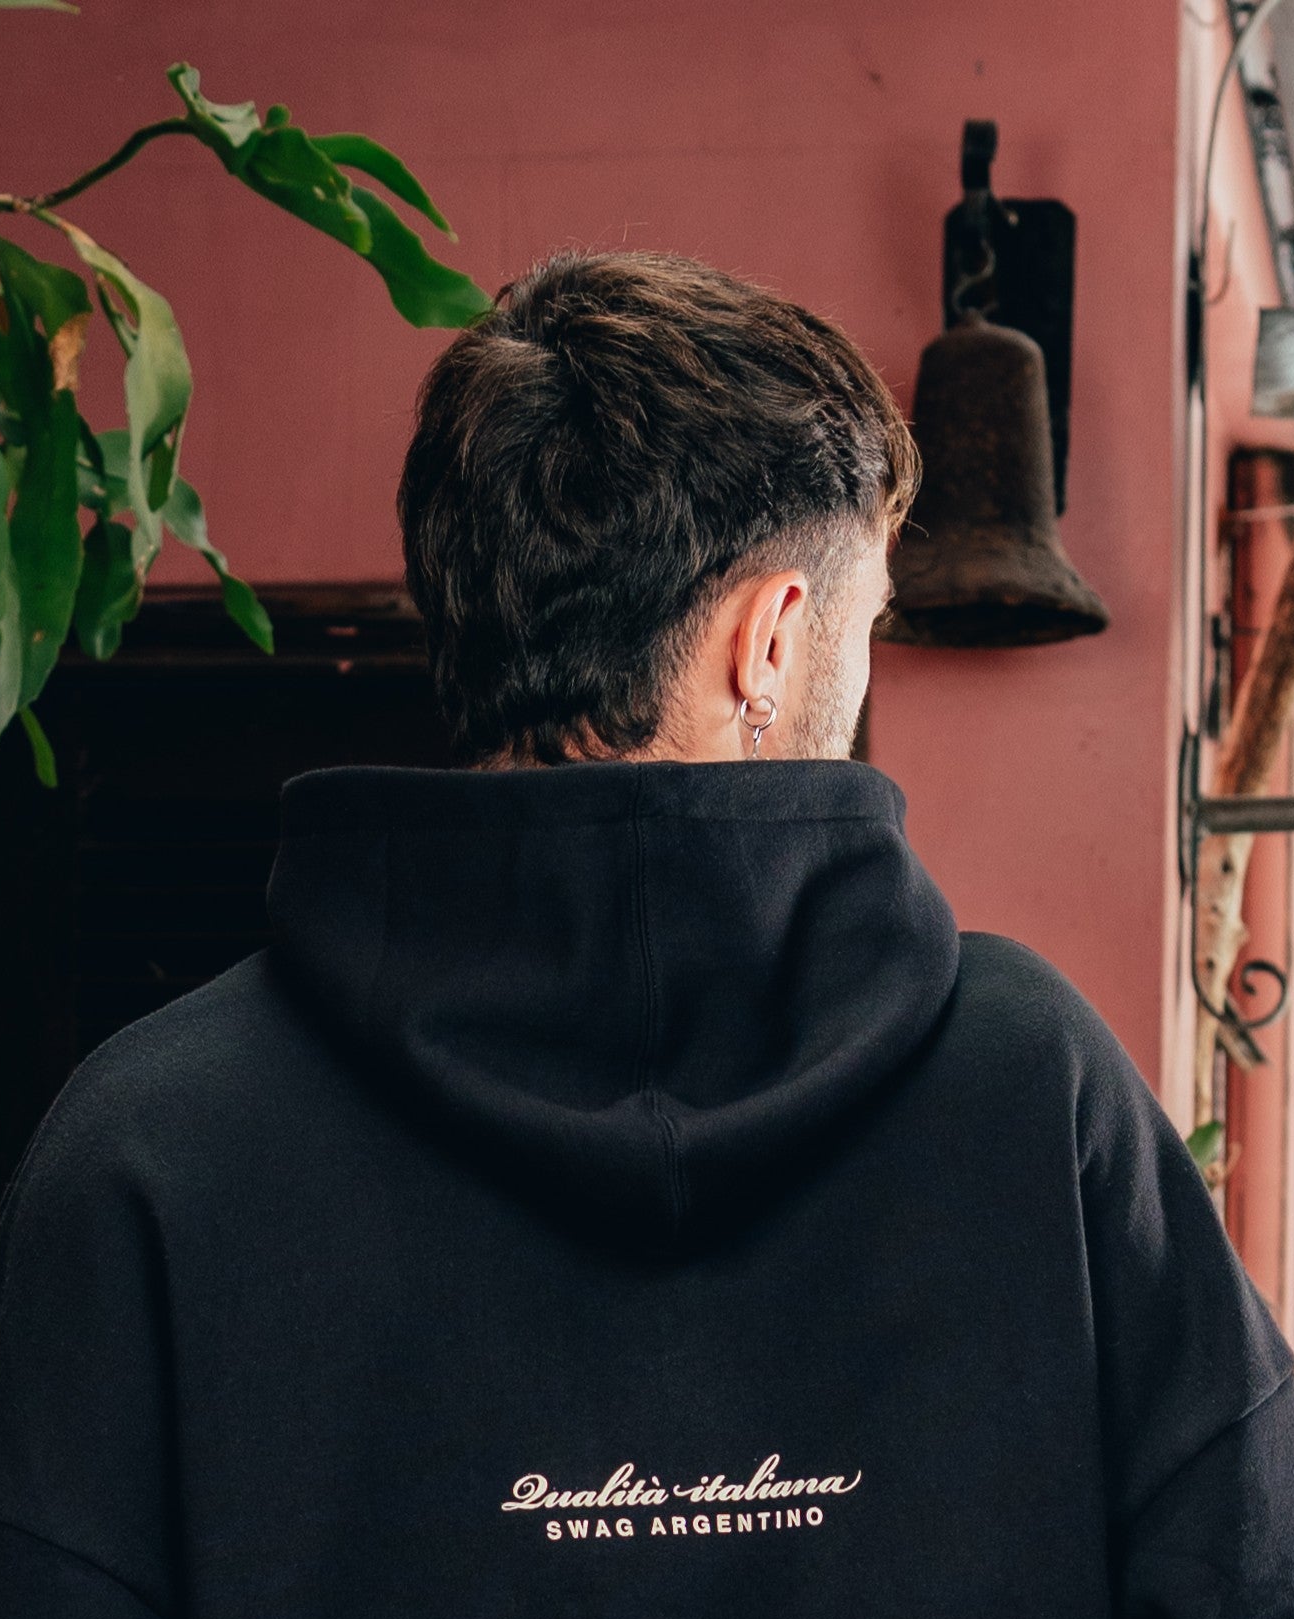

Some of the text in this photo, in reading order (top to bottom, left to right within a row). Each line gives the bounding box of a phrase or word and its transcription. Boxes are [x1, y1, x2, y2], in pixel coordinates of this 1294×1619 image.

[500, 1453, 862, 1512] Qualità italiana
[546, 1506, 824, 1541] SWAG ARGENTINO
